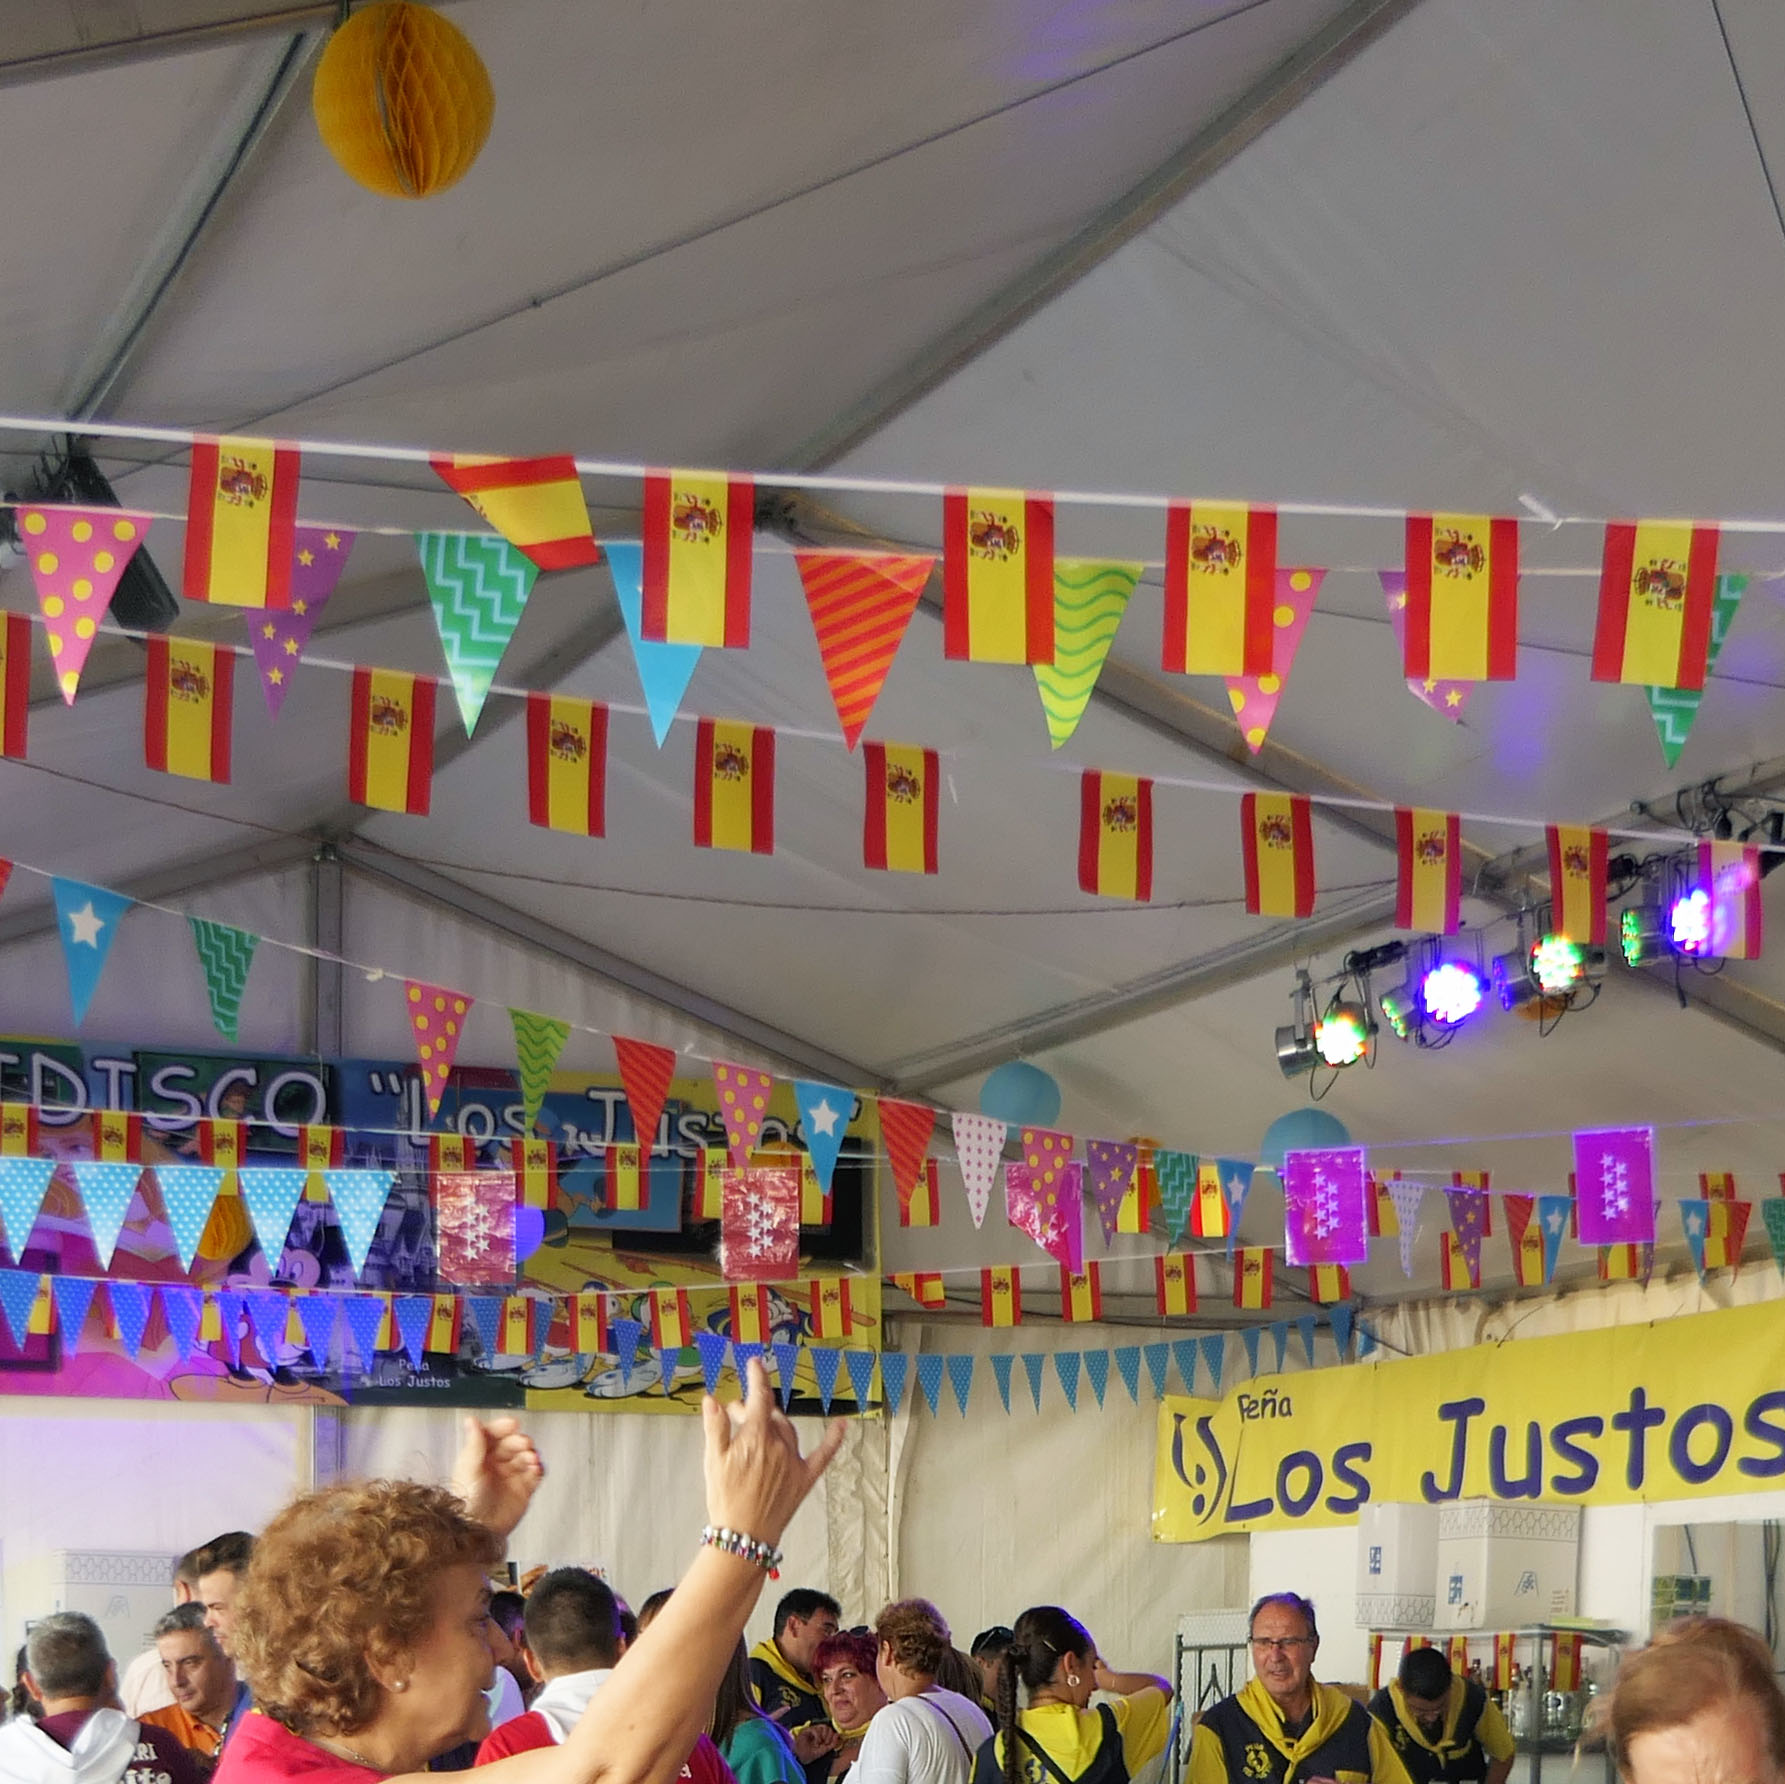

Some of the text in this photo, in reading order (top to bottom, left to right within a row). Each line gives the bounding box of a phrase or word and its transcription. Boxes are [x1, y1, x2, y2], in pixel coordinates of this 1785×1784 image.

[399, 1359, 430, 1371] Pea
[379, 1375, 451, 1388] Los Justos
